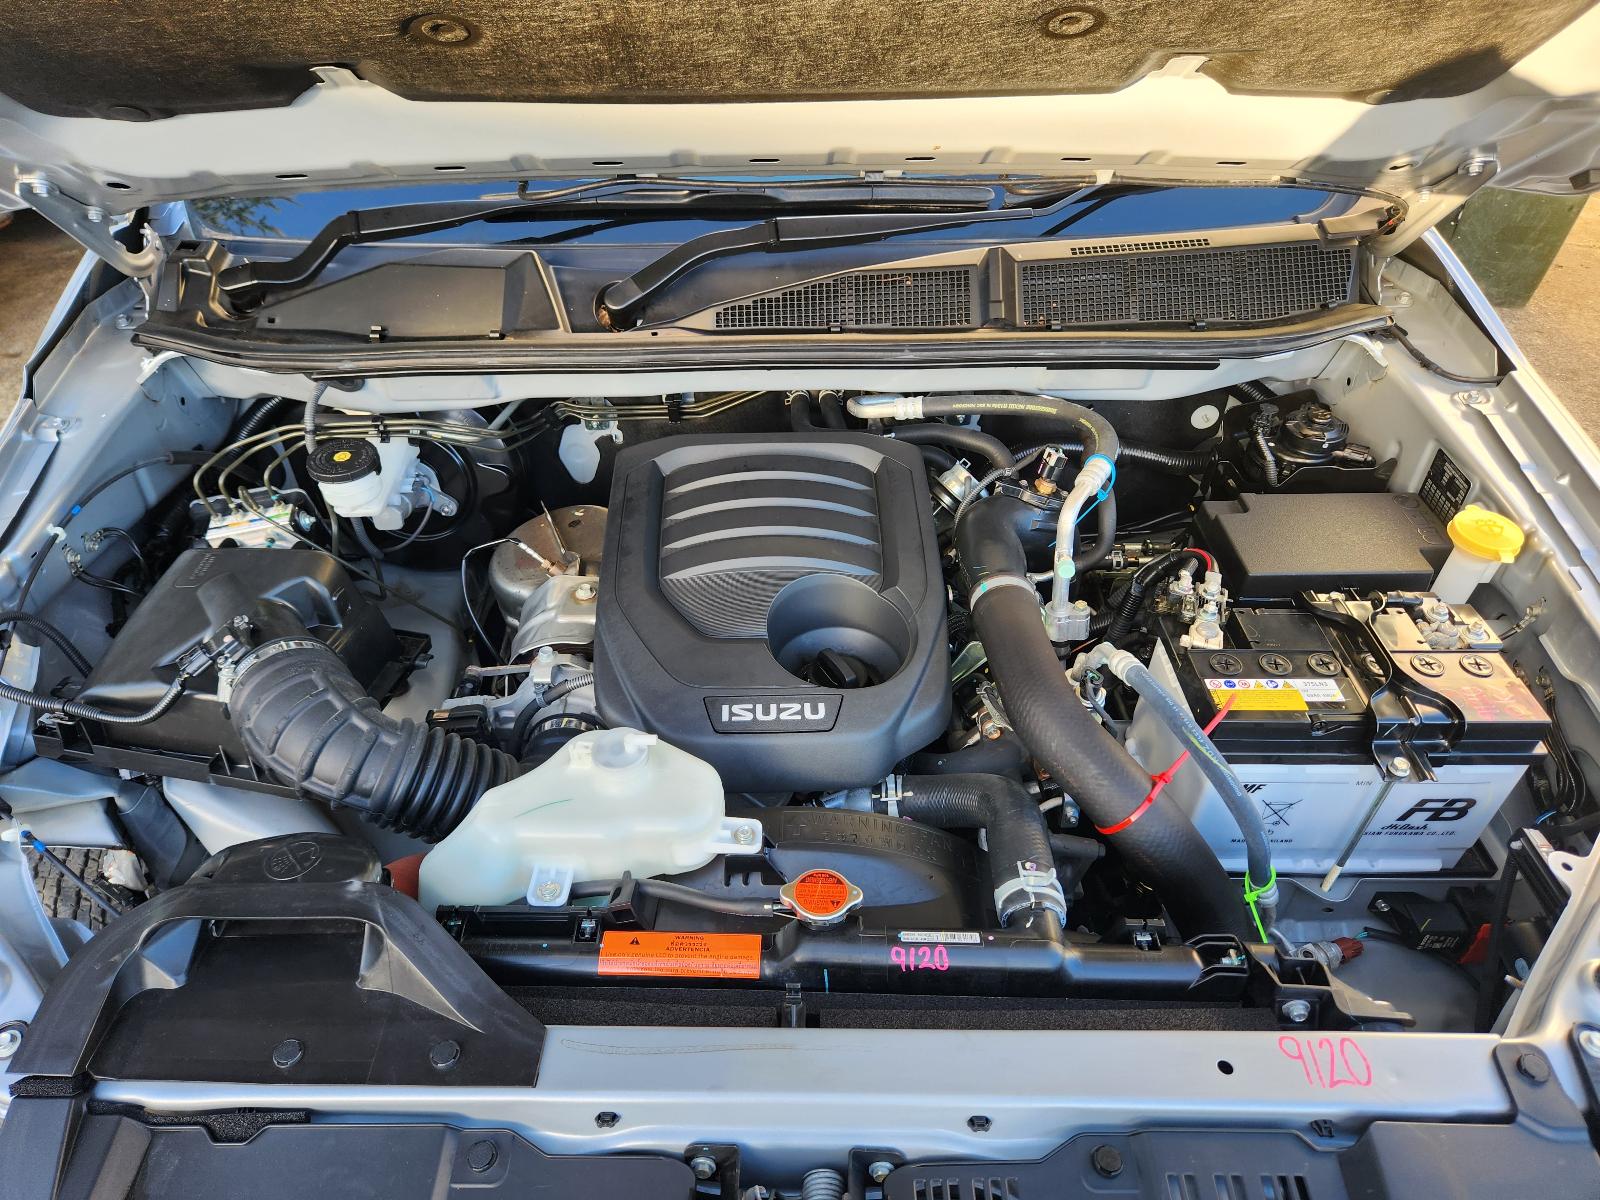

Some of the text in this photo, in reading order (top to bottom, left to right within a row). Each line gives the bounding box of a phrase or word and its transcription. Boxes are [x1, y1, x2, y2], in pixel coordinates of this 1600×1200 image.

[721, 702, 826, 722] ISUZU
[1395, 798, 1477, 822] FB
[890, 944, 950, 972] 9120
[1278, 1035, 1372, 1089] 9120
